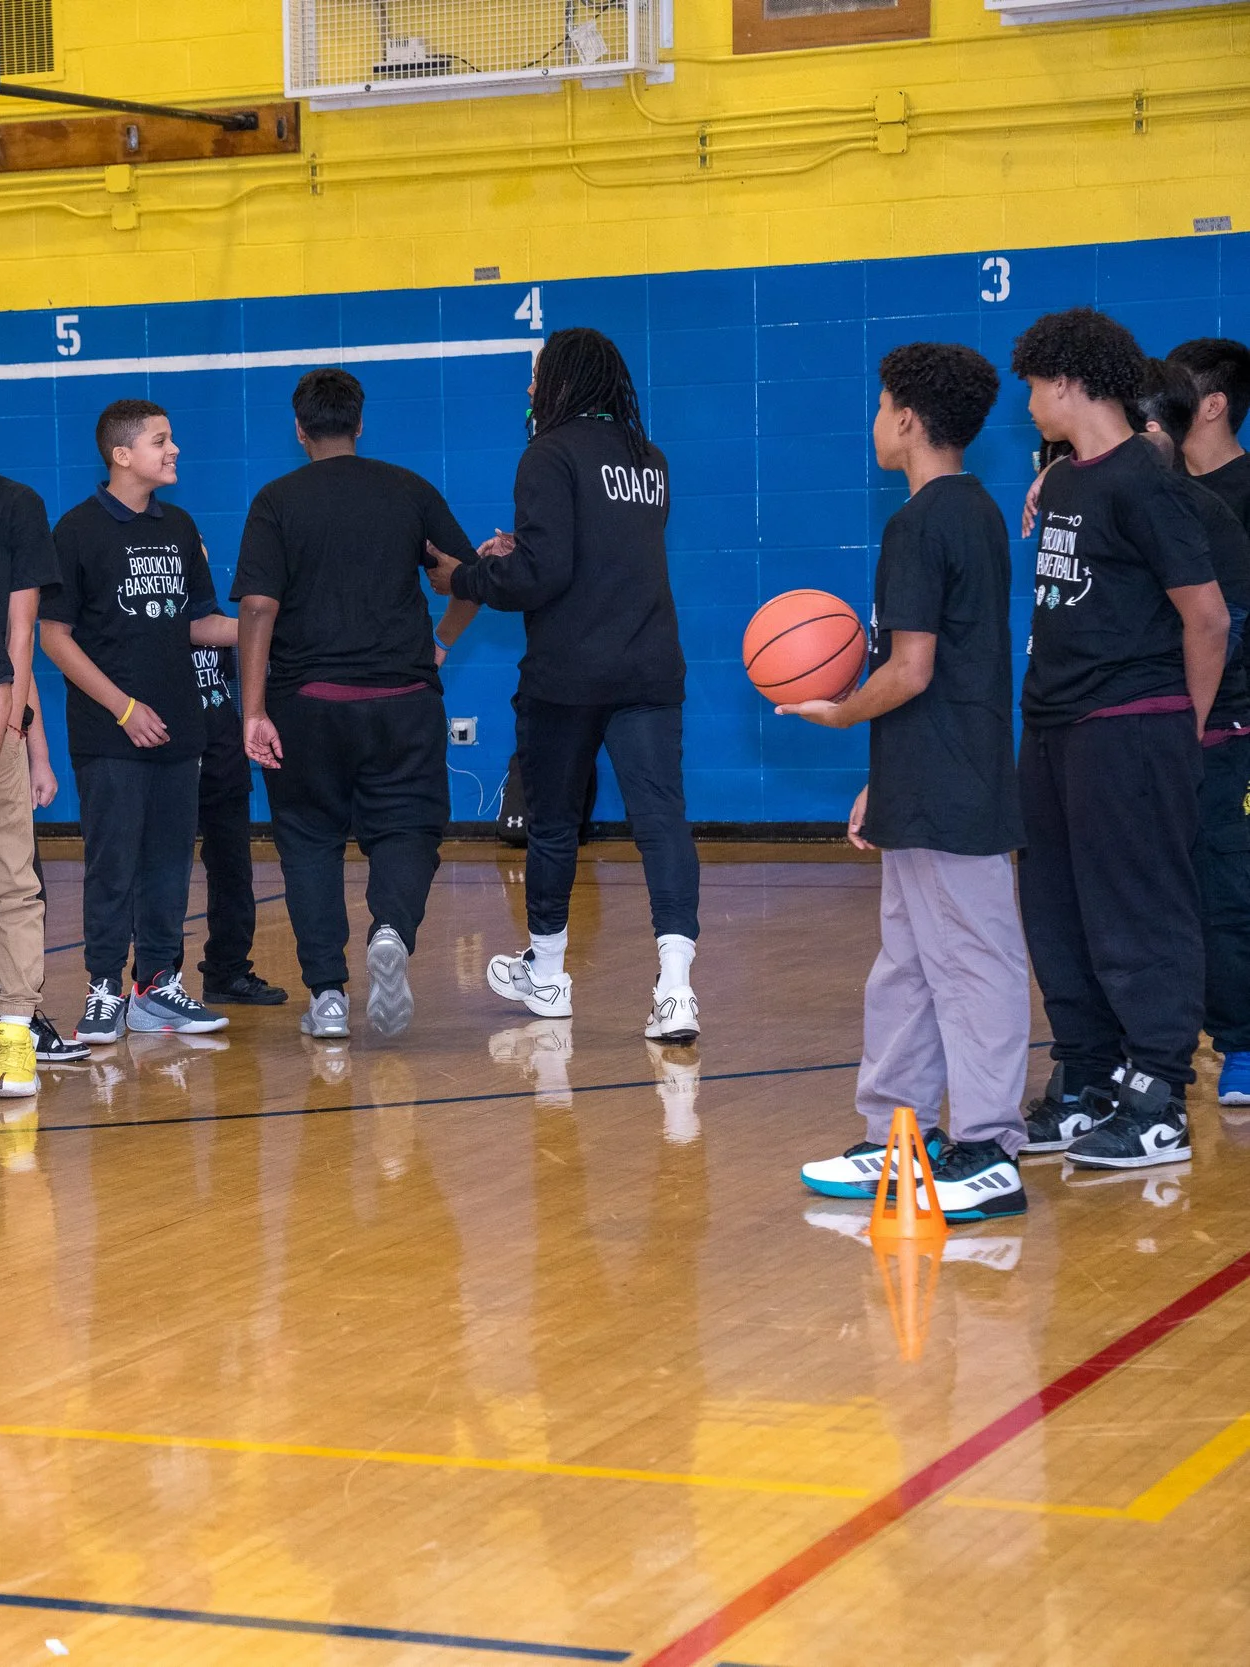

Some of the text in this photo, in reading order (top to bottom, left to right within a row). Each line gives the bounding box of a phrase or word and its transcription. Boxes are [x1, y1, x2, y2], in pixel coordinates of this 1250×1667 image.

[981, 257, 1010, 302] 3
[514, 287, 543, 330] 4
[56, 315, 81, 356] 5
[601, 465, 664, 507] COACH
[129, 556, 182, 576] BROOKLYN
